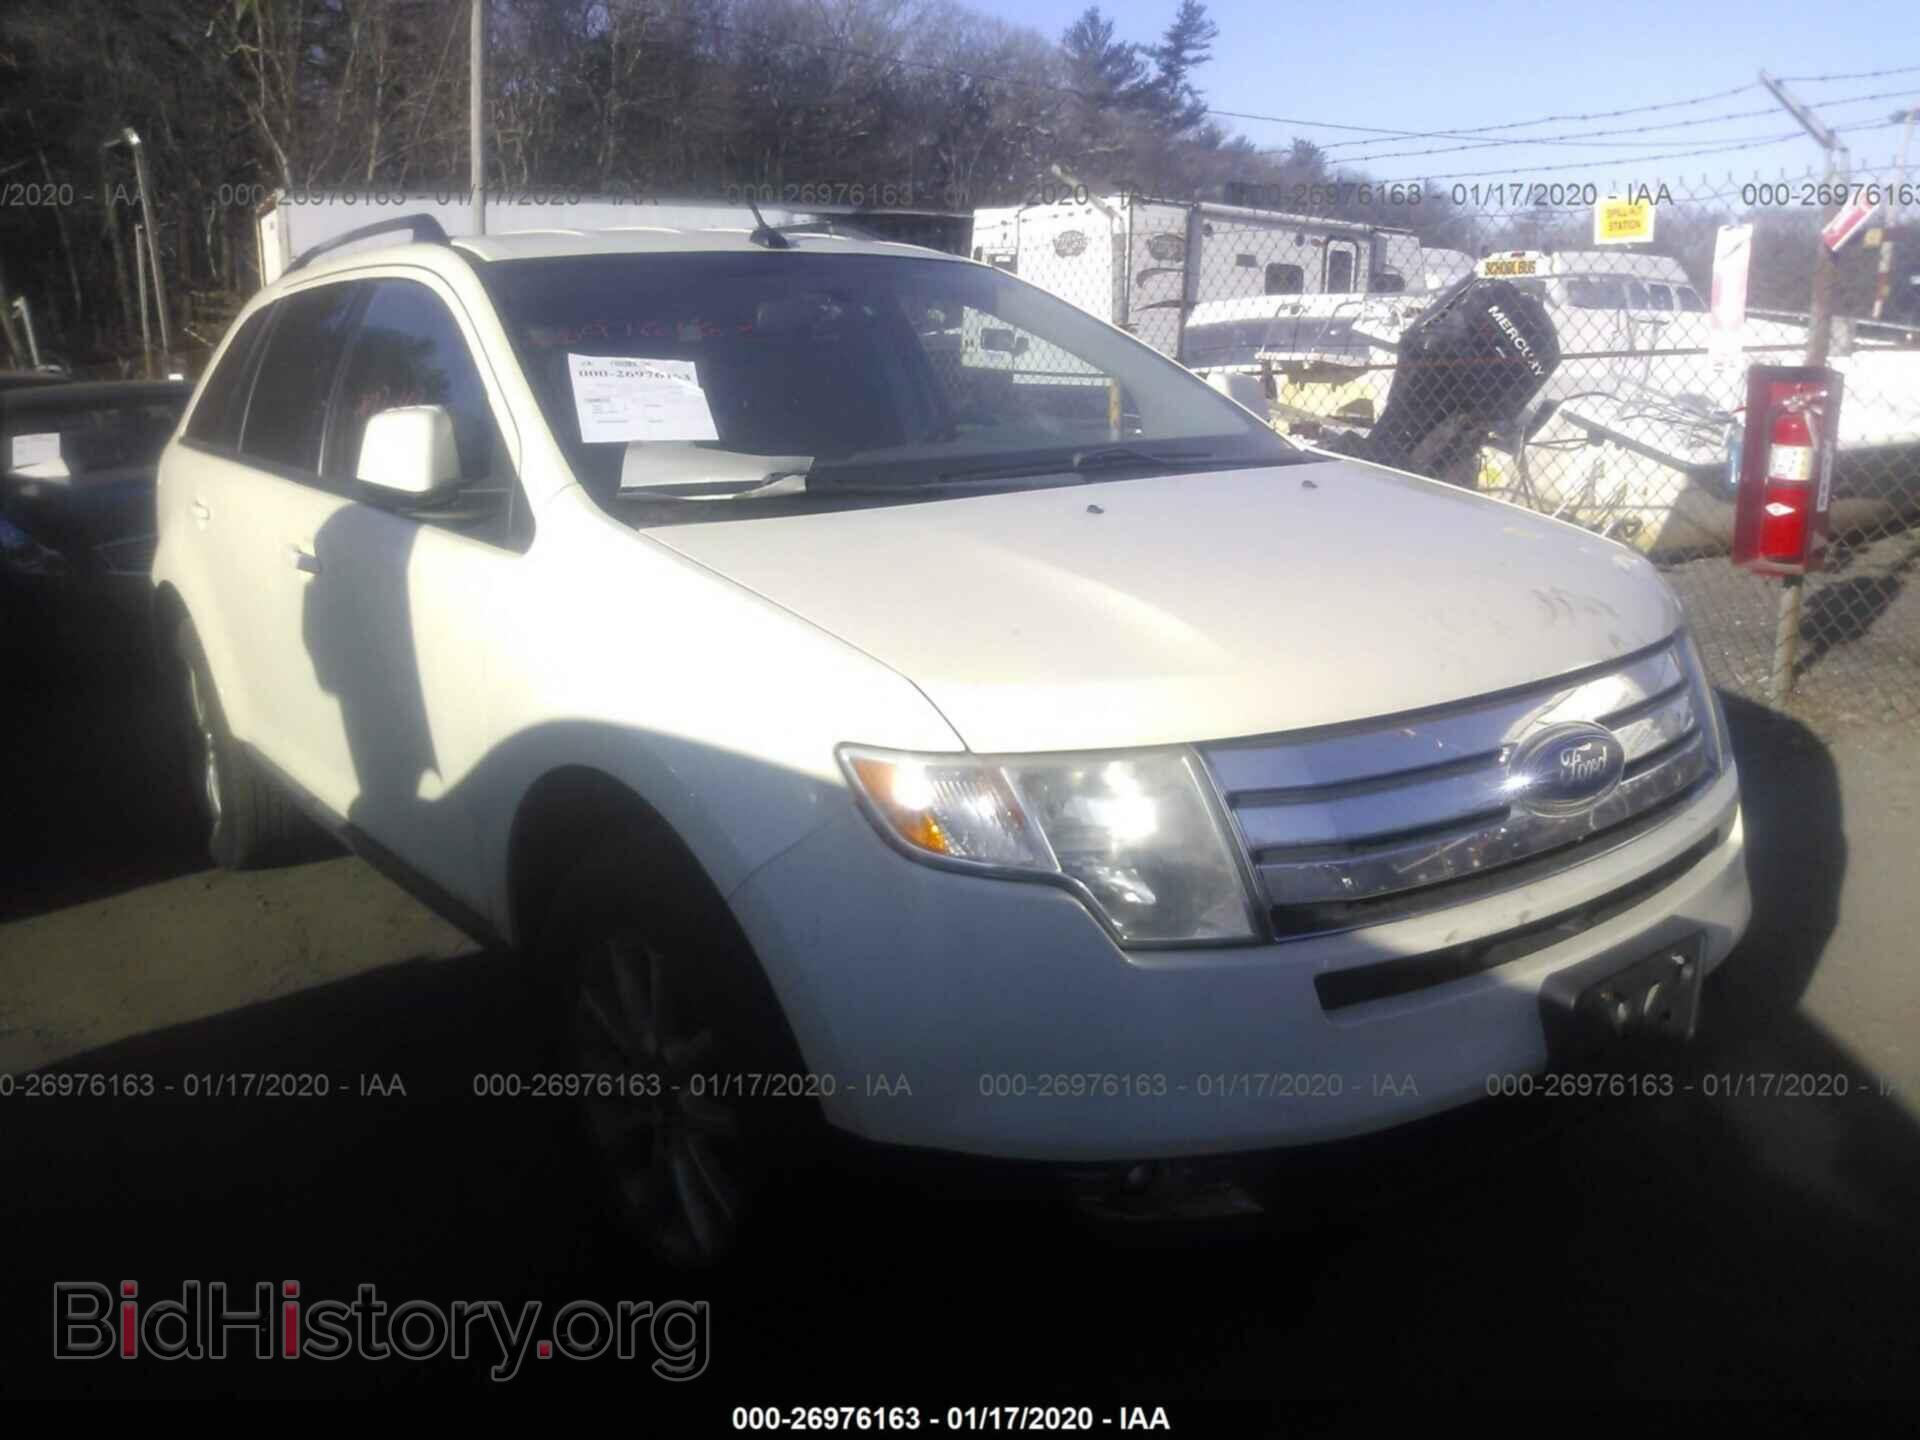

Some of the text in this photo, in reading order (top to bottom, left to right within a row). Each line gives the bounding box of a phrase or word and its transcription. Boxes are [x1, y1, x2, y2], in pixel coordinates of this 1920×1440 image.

[1607, 220, 1641, 231] STATION
[1485, 260, 1536, 275] SCHOOL BUS
[1560, 742, 1608, 773] Ford
